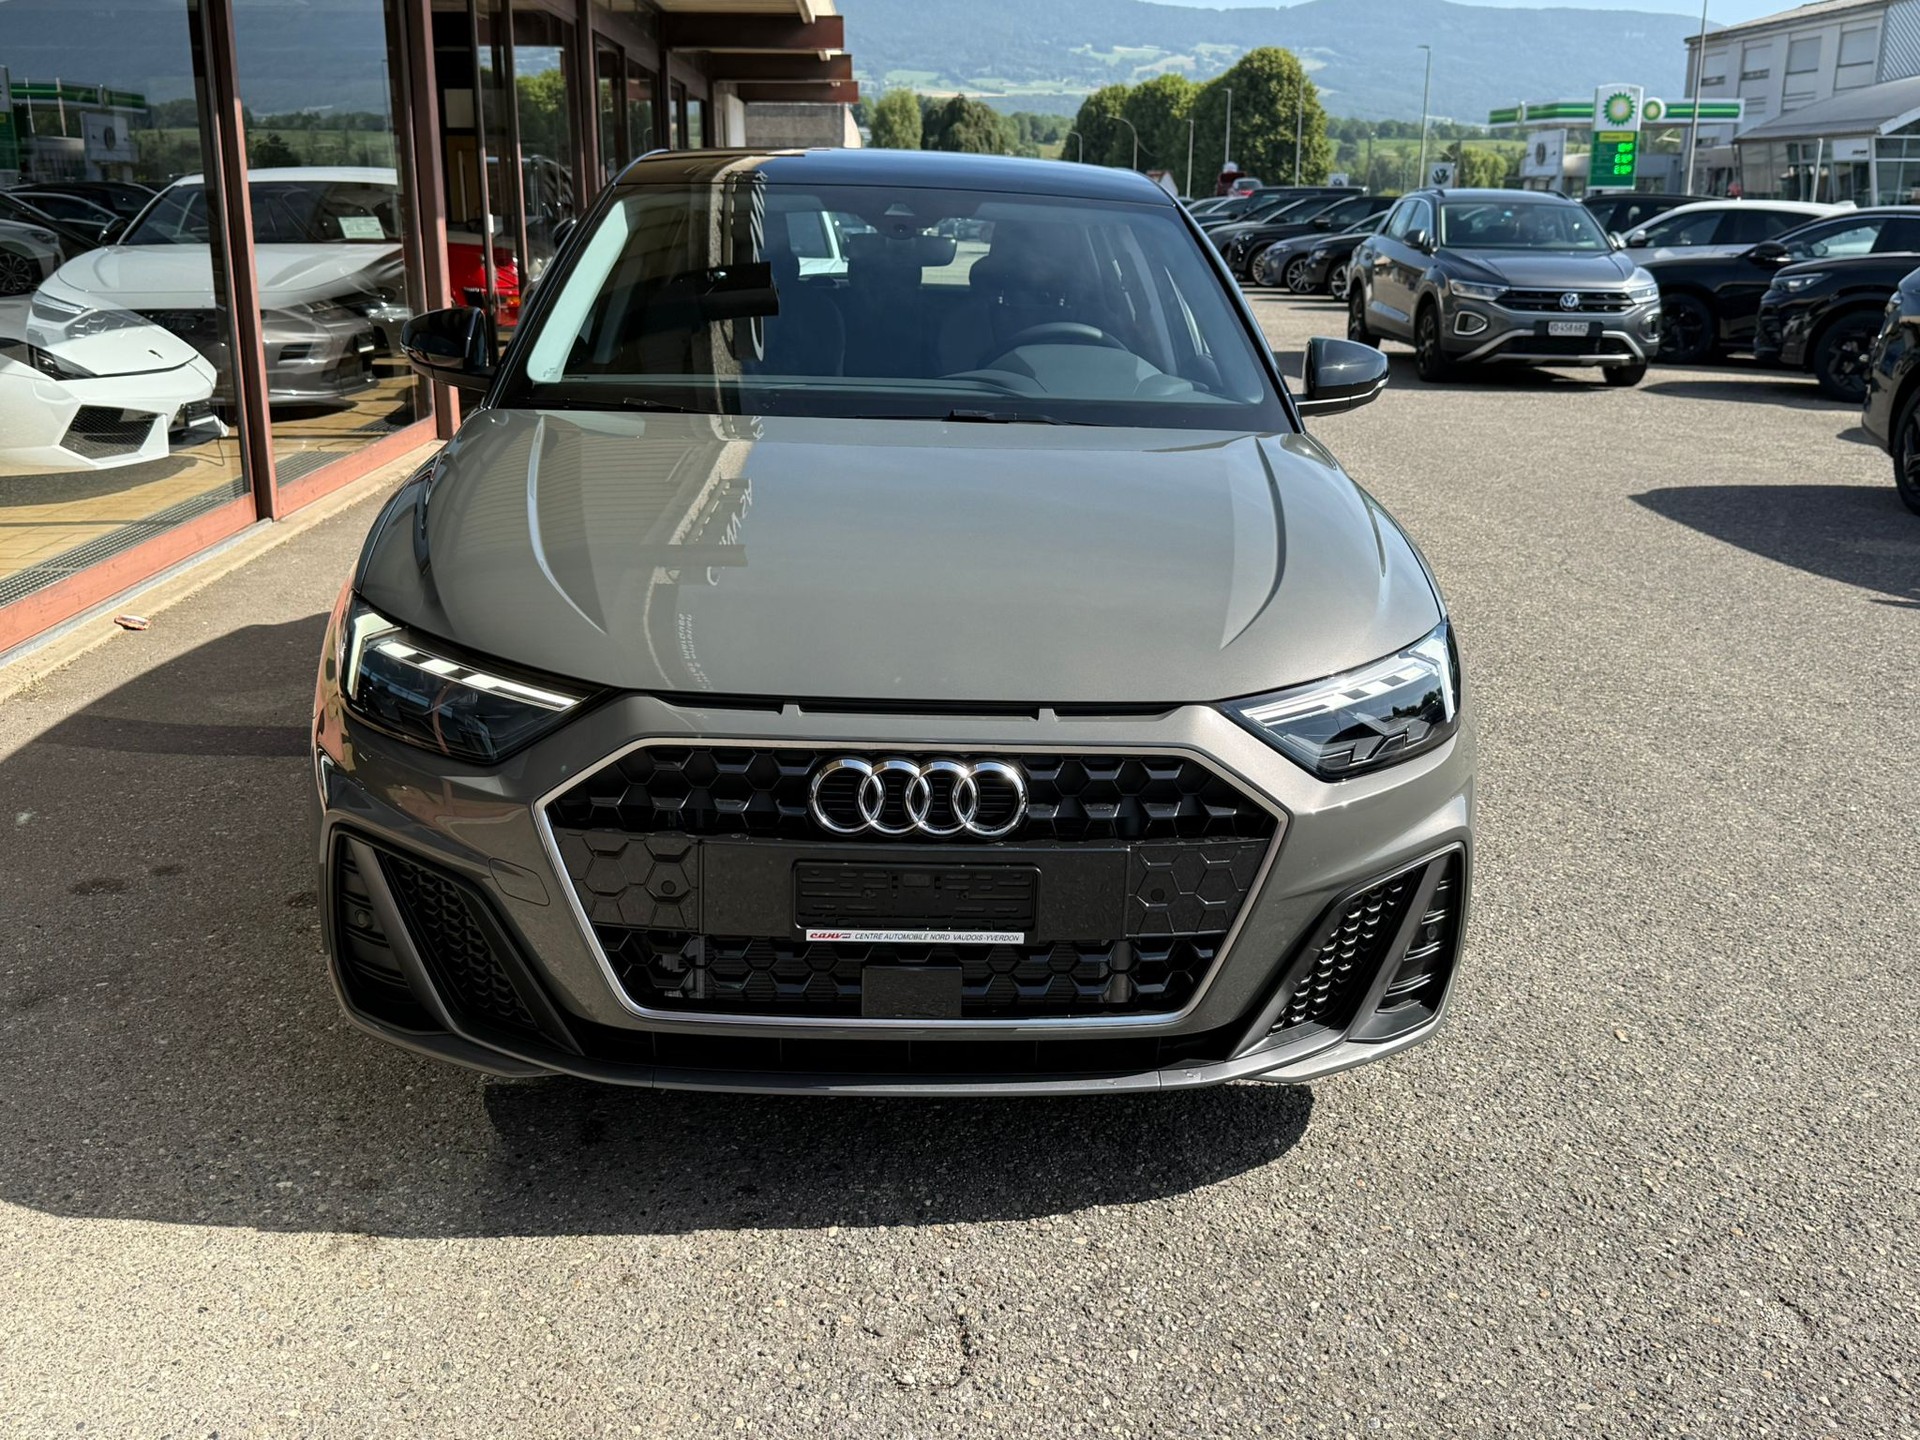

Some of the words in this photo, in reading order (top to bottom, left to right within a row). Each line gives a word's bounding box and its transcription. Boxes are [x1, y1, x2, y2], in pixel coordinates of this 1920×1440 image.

[854, 932, 883, 940] CENTRE
[884, 933, 929, 941] AUTOMOBILE
[929, 933, 951, 941] NORD
